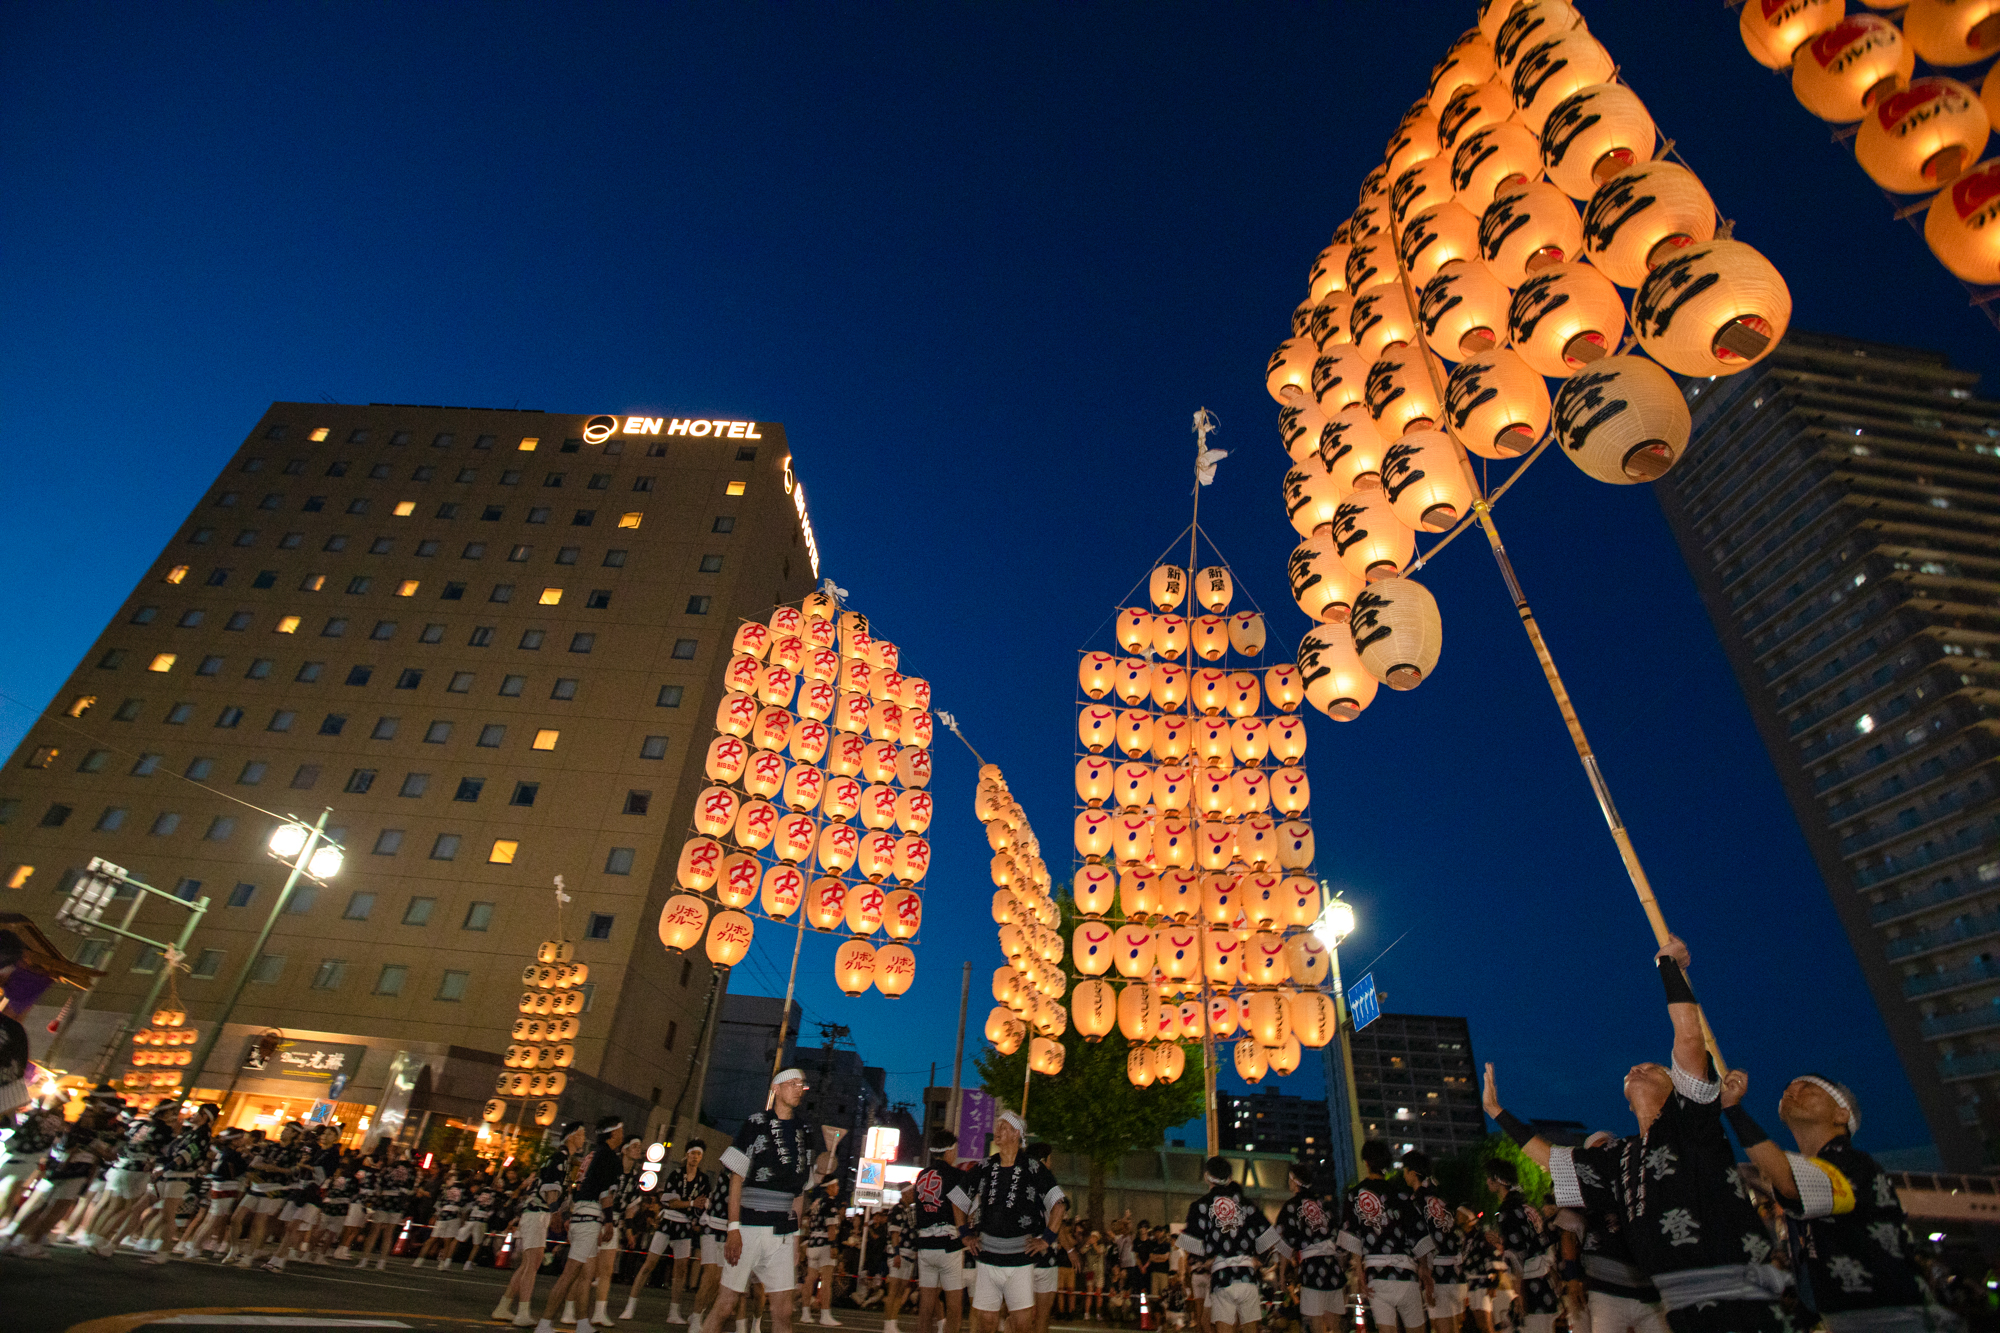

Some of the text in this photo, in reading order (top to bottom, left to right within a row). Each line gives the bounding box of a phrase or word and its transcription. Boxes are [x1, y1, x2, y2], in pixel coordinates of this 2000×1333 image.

[622, 416, 762, 439] EN HOTEL
[1165, 567, 1181, 595] 新屋
[1208, 567, 1225, 592] 新屋
[676, 905, 703, 919] リボン
[725, 922, 750, 936] リボン
[852, 951, 874, 962] リボン
[1645, 1144, 1678, 1180] 登
[1659, 1208, 1700, 1247] 登
